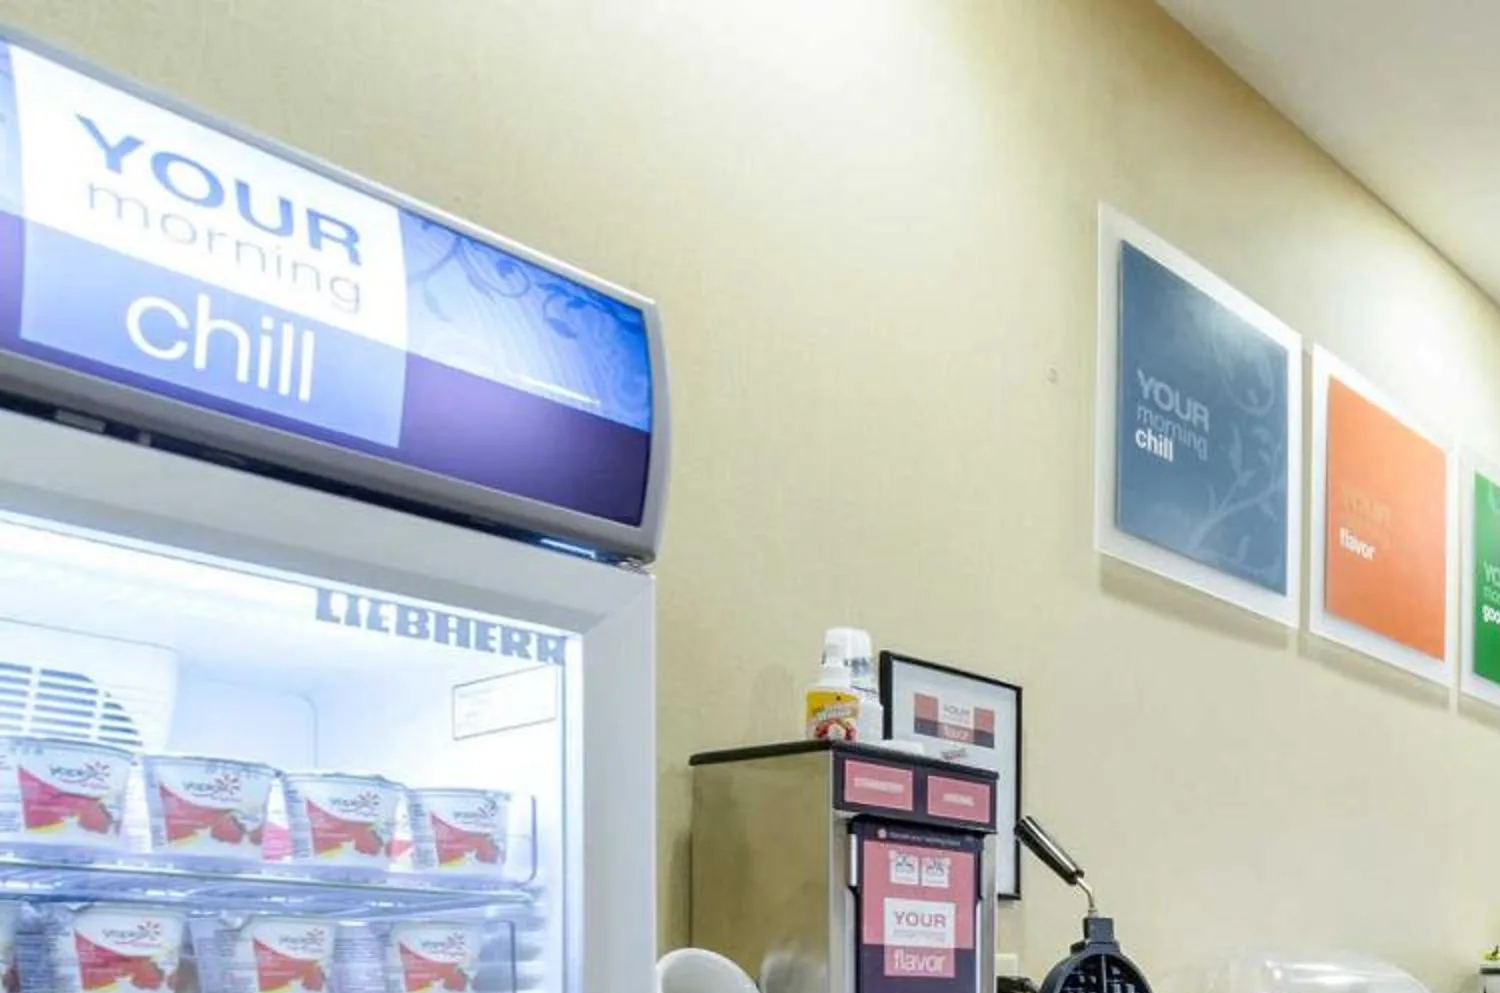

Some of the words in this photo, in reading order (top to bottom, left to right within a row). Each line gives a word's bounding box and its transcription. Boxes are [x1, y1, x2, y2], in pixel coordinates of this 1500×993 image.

[74, 112, 362, 267] YOUR
[88, 181, 361, 315] morning
[126, 292, 316, 404] chill
[1136, 367, 1209, 434] YOUR
[1135, 428, 1173, 463] chill
[1136, 404, 1208, 462] morning
[1339, 527, 1376, 561] flavor
[315, 588, 568, 668] LIEBHERR
[894, 910, 947, 930] YOUR
[893, 948, 947, 973] flavor
